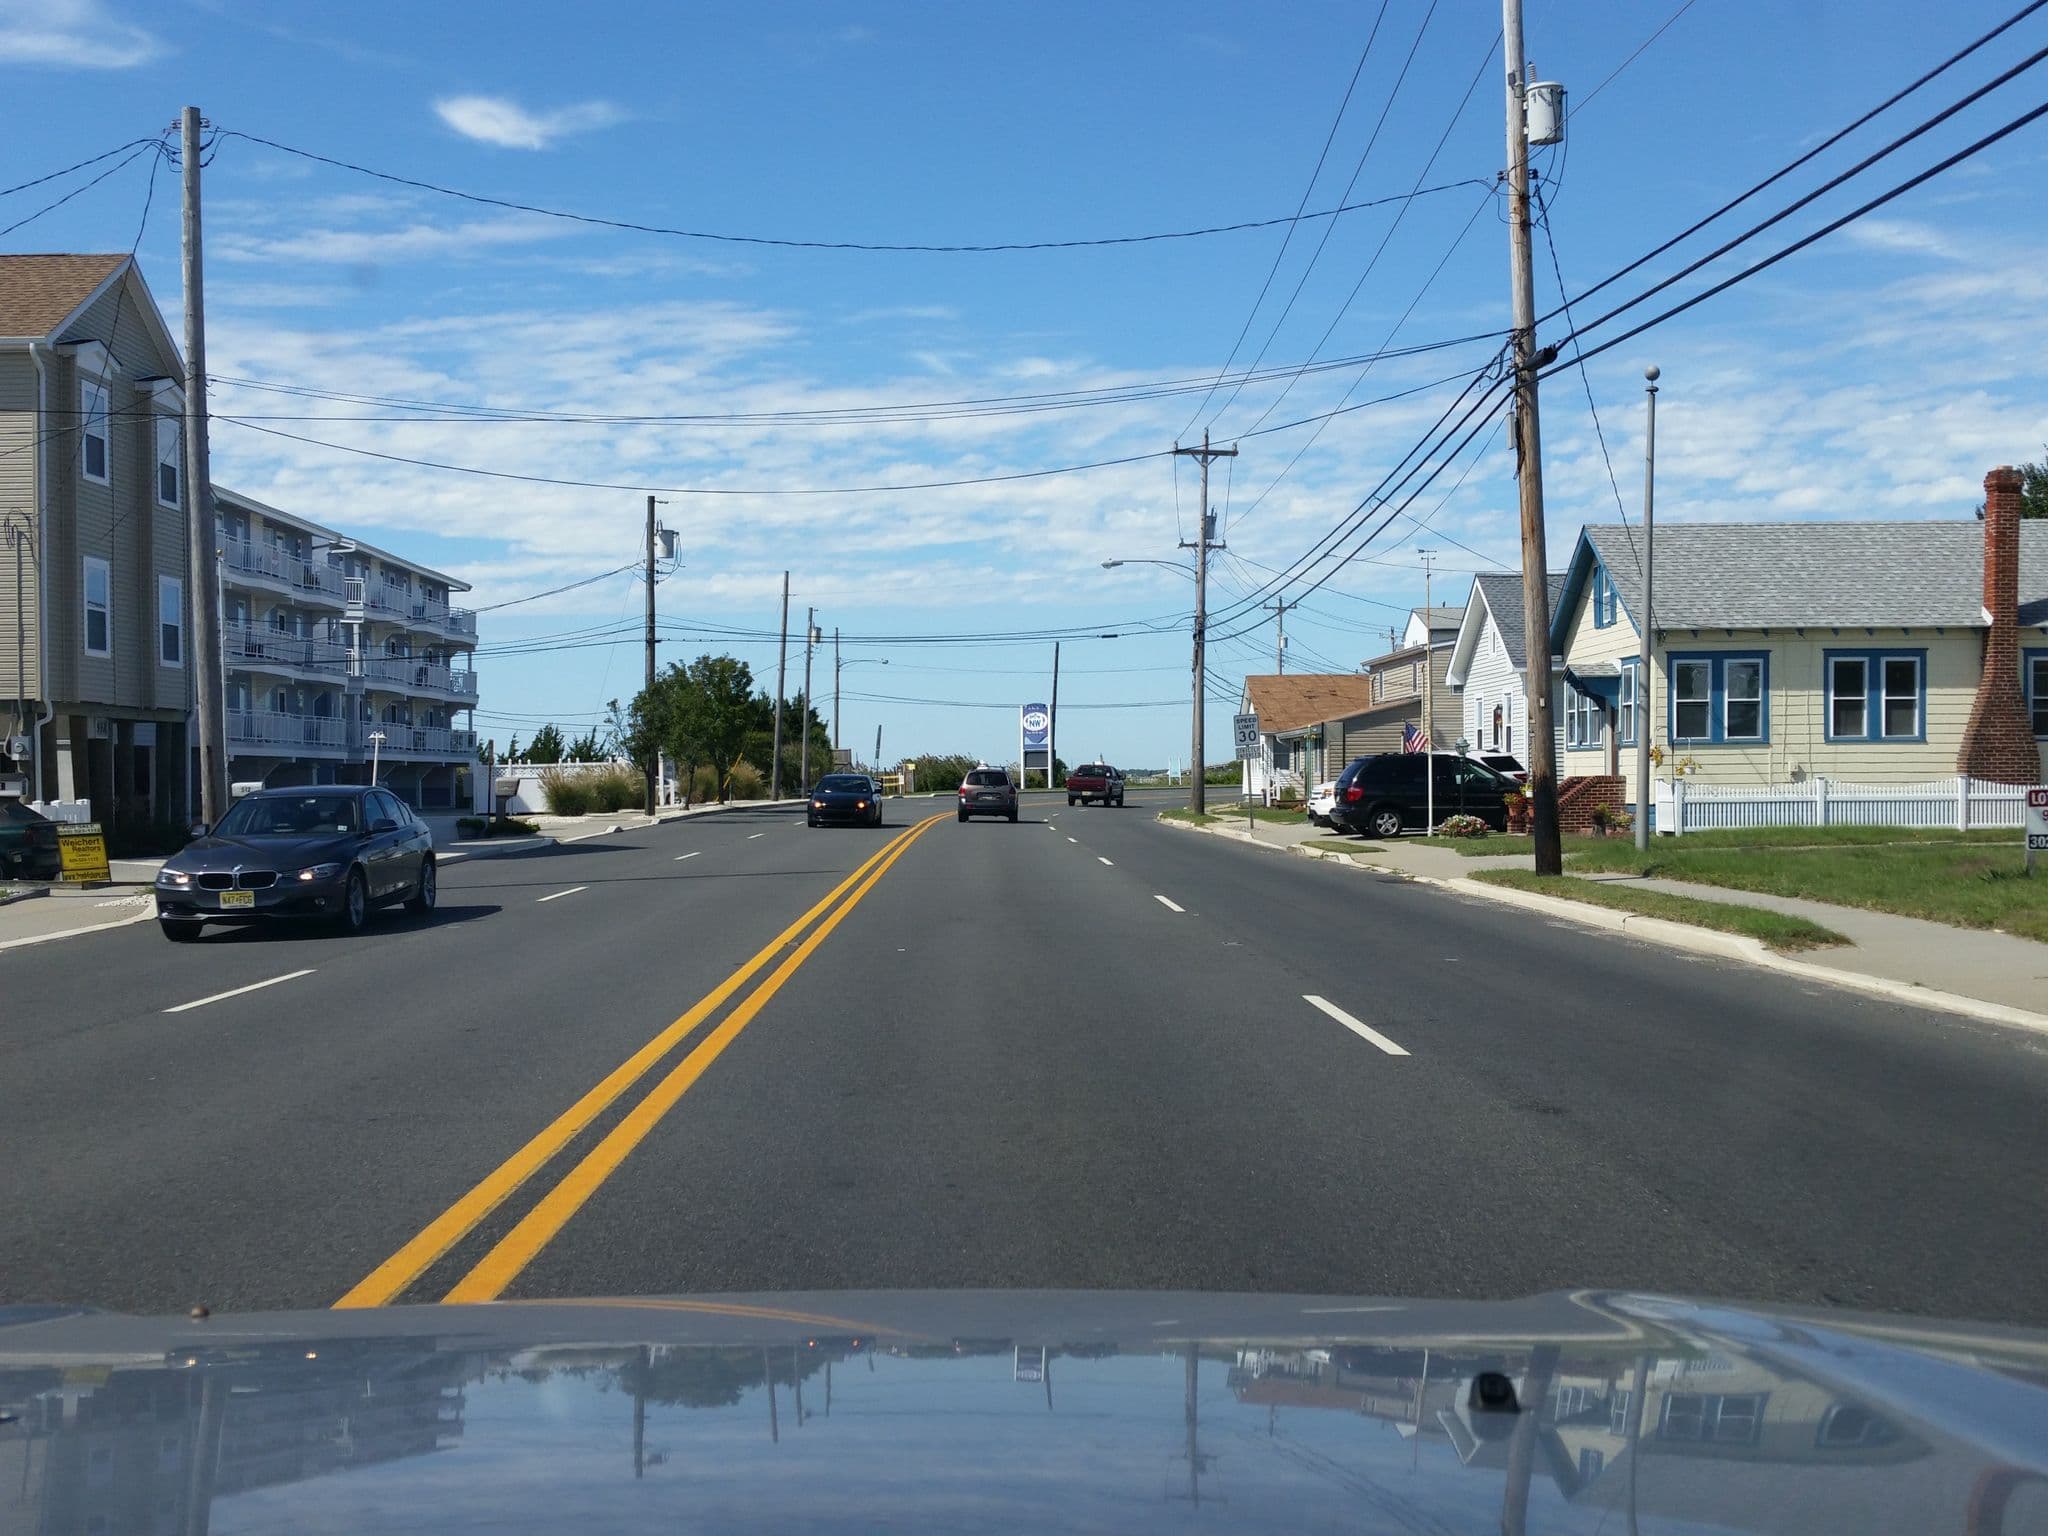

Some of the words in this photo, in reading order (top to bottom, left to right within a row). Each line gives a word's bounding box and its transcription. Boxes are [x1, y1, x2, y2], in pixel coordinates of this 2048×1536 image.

[1239, 730, 1256, 742] 30
[2032, 792, 2048, 805] LO
[61, 838, 99, 847] Weichert
